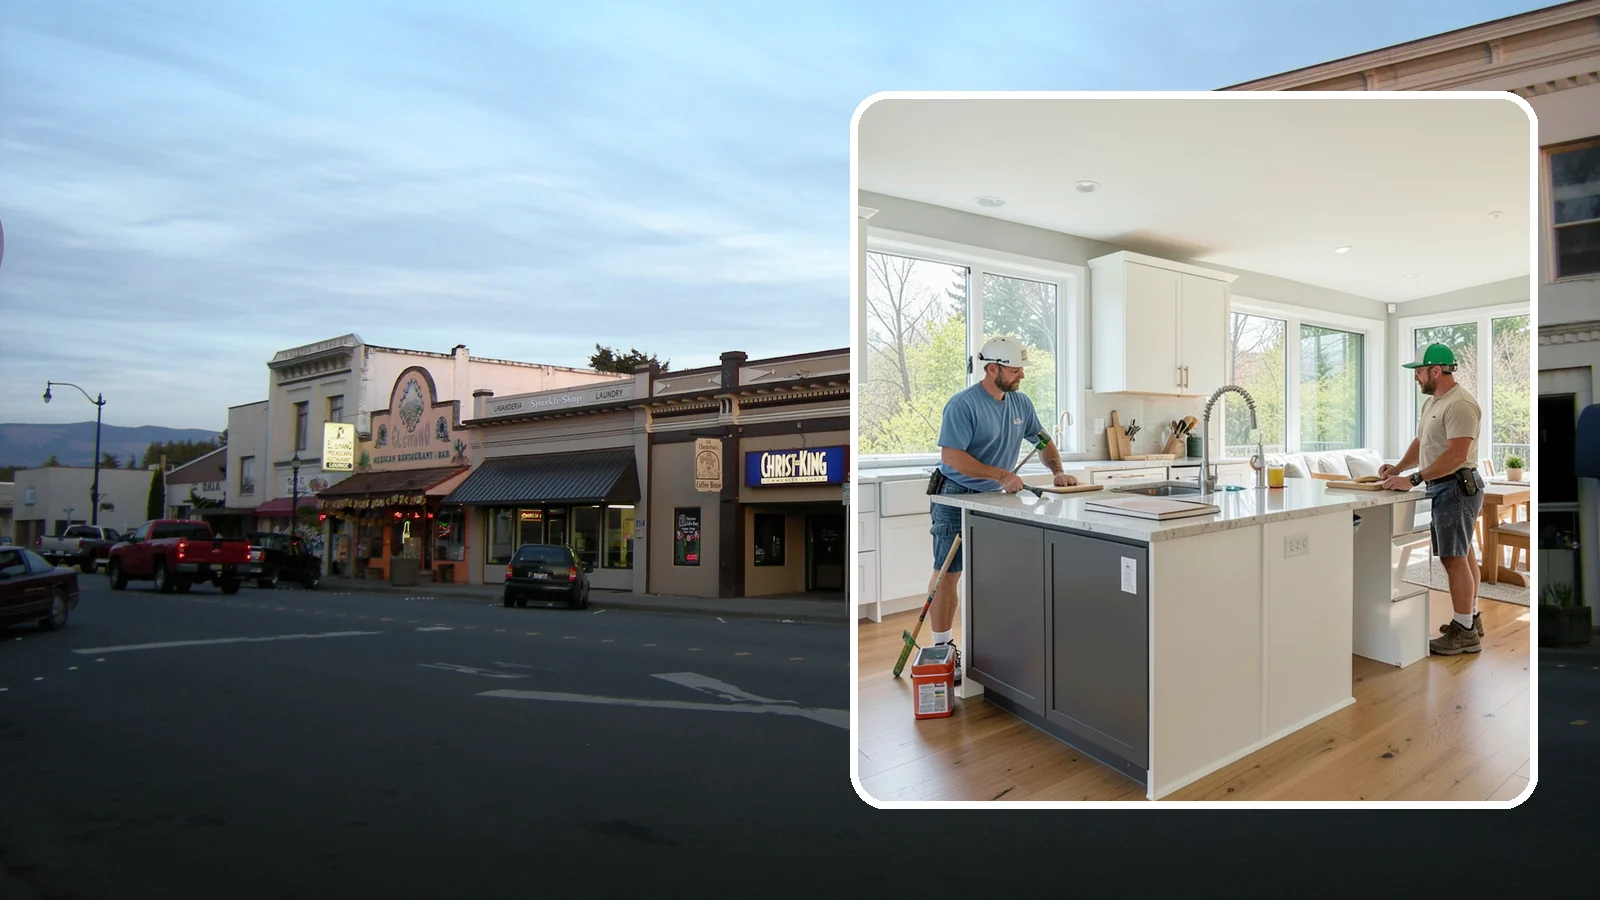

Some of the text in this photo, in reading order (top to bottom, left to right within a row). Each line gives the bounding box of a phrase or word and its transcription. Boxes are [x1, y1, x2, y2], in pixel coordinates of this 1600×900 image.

[595, 389, 623, 400] LAUNDRY
[493, 402, 522, 413] LAVANDERIA
[530, 394, 584, 409] Sparkle Shop
[373, 450, 450, 464] MEXICAN RESTAURANT BAR
[760, 449, 827, 478] CHRIST KING
[696, 480, 721, 489] Coffee House
